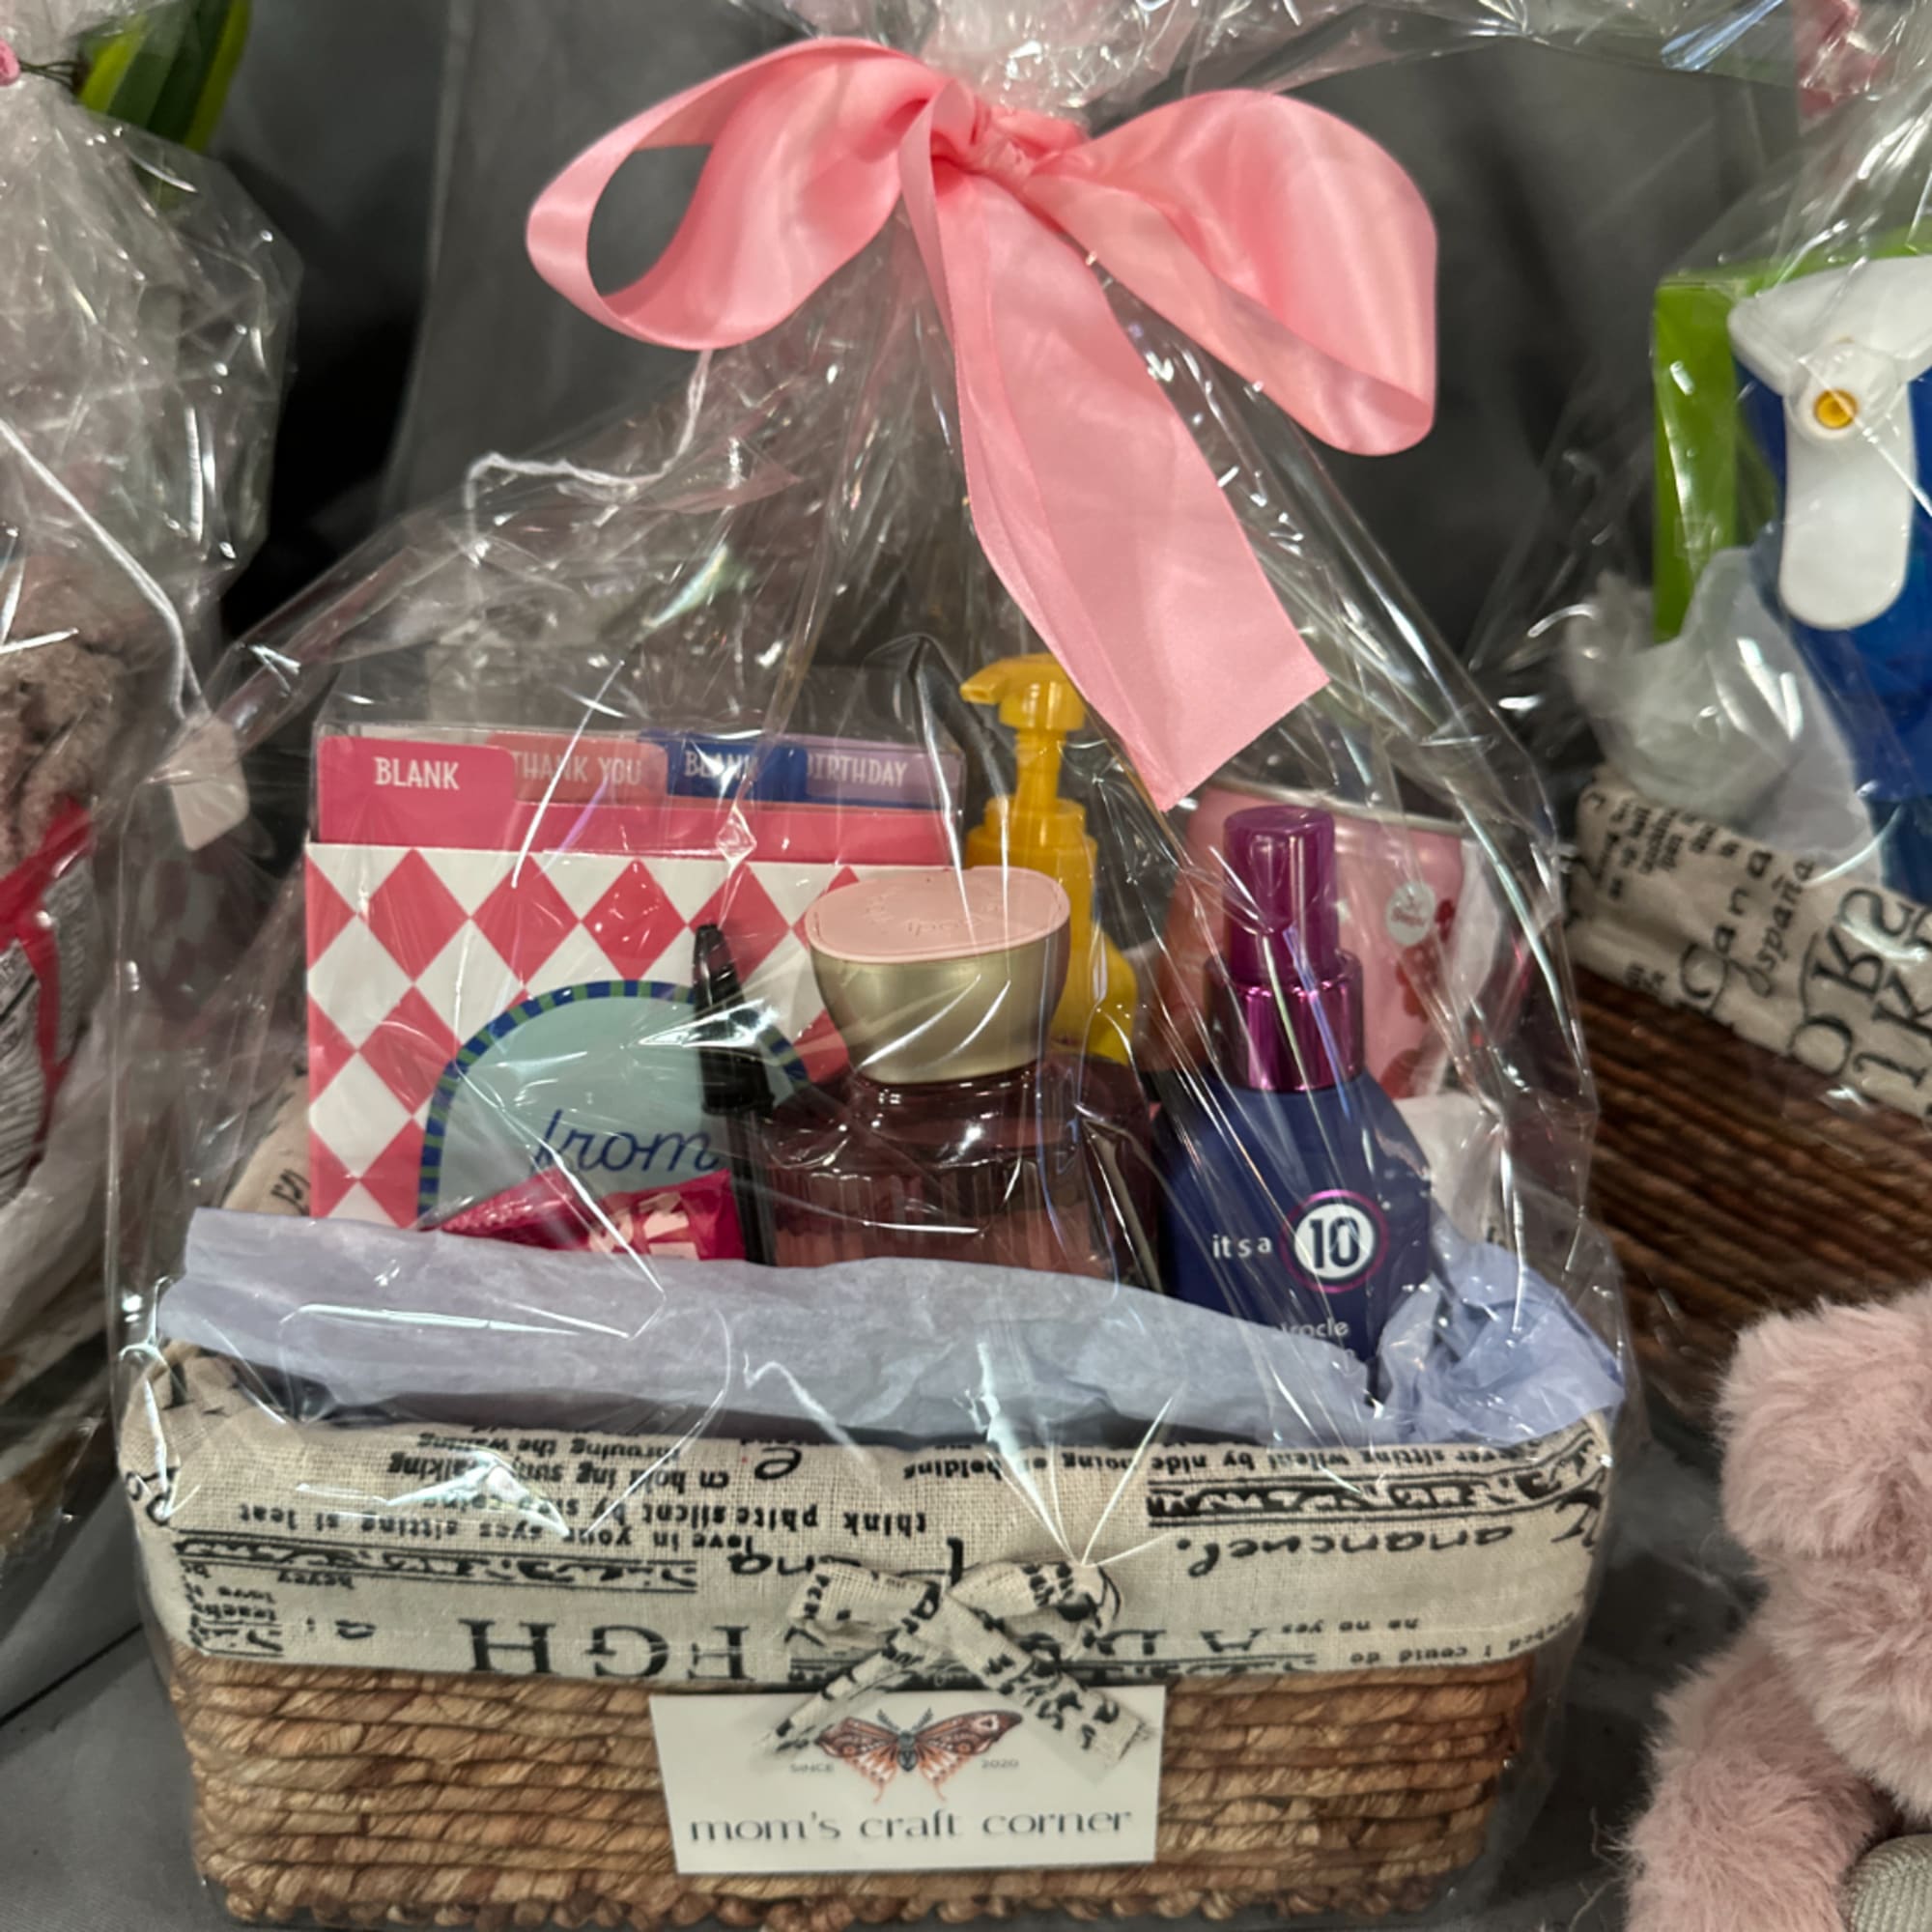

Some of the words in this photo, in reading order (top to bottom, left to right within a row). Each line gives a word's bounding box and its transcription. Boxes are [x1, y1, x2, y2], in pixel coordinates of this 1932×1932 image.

[373, 756, 461, 791] BLANK
[513, 750, 588, 783] THANK
[598, 756, 643, 786] YOU
[531, 1109, 721, 1175] from
[1257, 1236, 1273, 1255] a
[1309, 1216, 1361, 1269] 10
[1222, 1449, 1255, 1471] by
[562, 1525, 634, 1547] your
[842, 1511, 926, 1539] think
[653, 1531, 678, 1552] in
[980, 1757, 1020, 1770] 2020
[689, 1810, 841, 1843] mom's
[859, 1807, 962, 1840] craft
[981, 1808, 1133, 1835] corner
